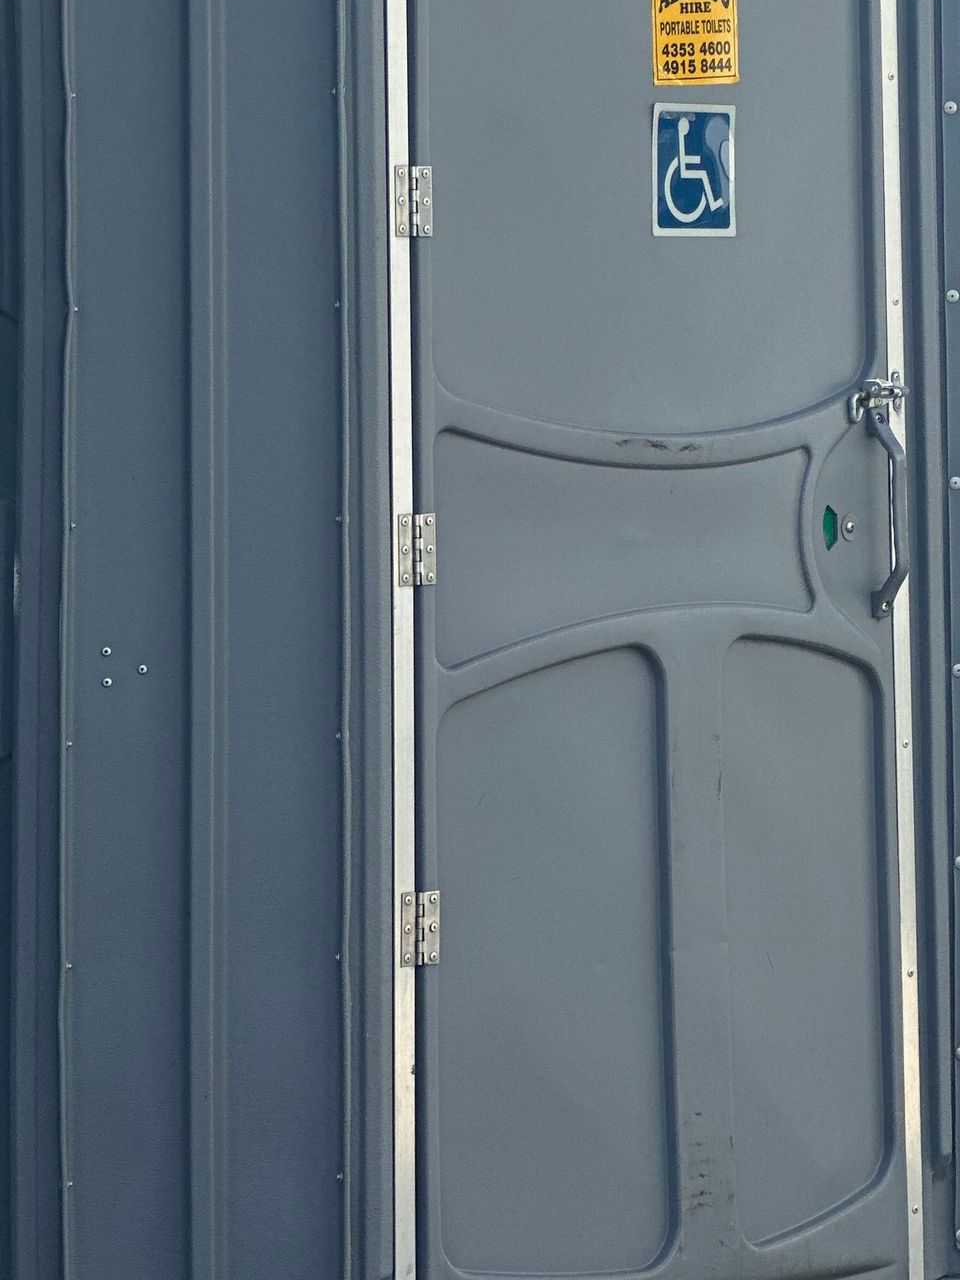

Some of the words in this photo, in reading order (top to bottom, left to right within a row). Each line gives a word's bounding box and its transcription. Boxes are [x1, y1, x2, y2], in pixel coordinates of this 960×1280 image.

[679, 2, 712, 14] HIRE
[660, 20, 700, 36] PORTABLE
[701, 18, 732, 34] TOILETS
[662, 42, 696, 58] 4353
[699, 41, 731, 56] 4600
[663, 59, 697, 75] 4915
[700, 58, 732, 74] 8444
